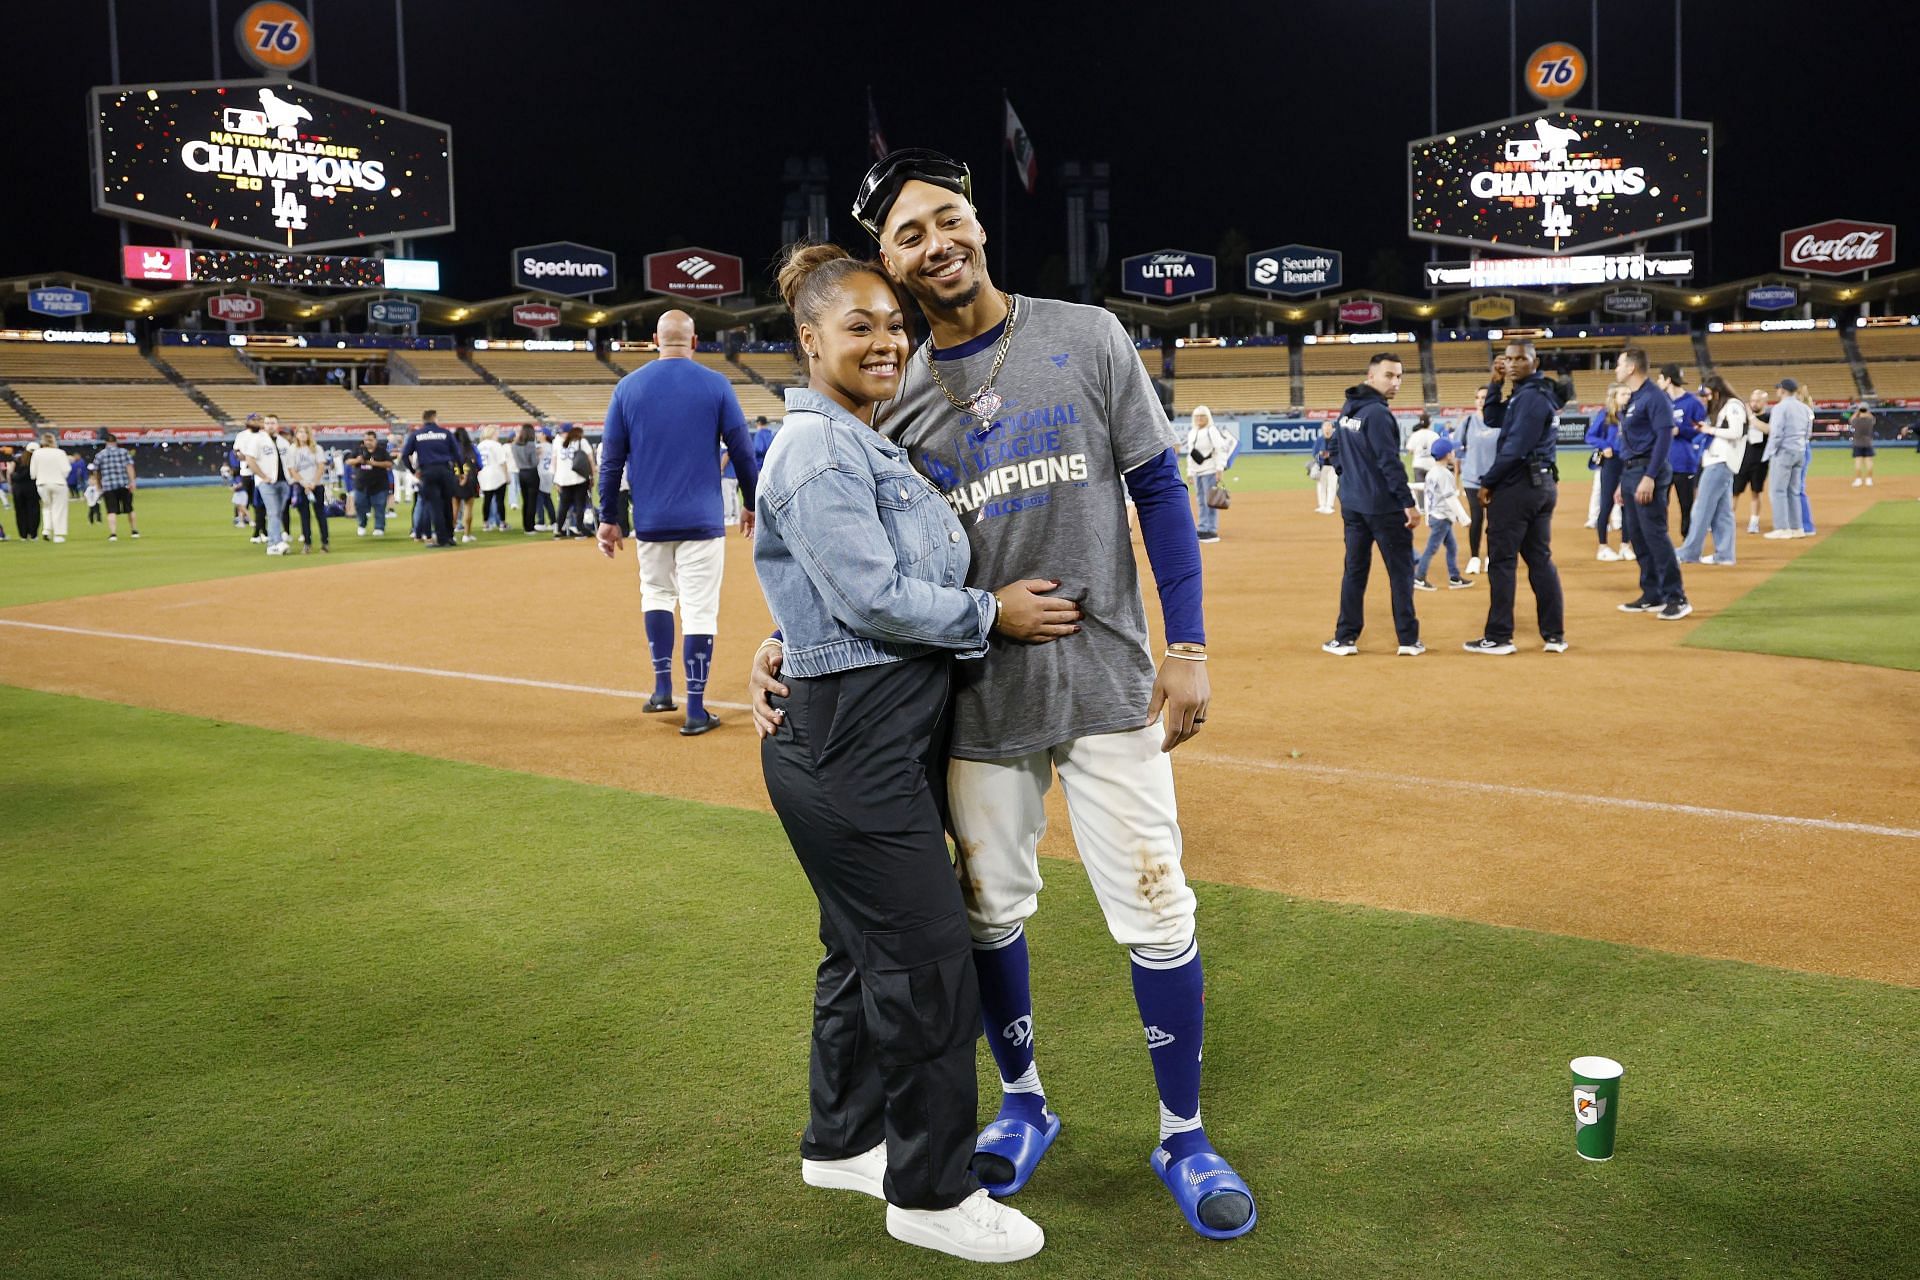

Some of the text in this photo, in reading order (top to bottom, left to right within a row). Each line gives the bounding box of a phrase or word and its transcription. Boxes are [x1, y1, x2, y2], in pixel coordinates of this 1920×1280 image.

[256, 21, 298, 51] 76
[1537, 56, 1575, 87] 76
[211, 131, 359, 159] NATIONAL LEAGUE
[182, 140, 386, 191] CHAMPIONS
[1494, 158, 1621, 172] NATIONAL LEAGUE
[236, 176, 262, 191] 20
[1471, 167, 1646, 198] CHAMPIONS
[271, 180, 307, 229] LA
[1542, 195, 1572, 237] LA
[524, 257, 603, 278] Spectrum
[1142, 264, 1195, 278] ULTRA
[1282, 256, 1333, 271] Security
[1283, 269, 1326, 284] Benefit
[36, 292, 75, 302] TOYO
[218, 299, 256, 315] JINRO
[1256, 424, 1323, 446] Spectru
[973, 430, 1062, 473] LEAGUE
[985, 498, 1023, 518] NLCS
